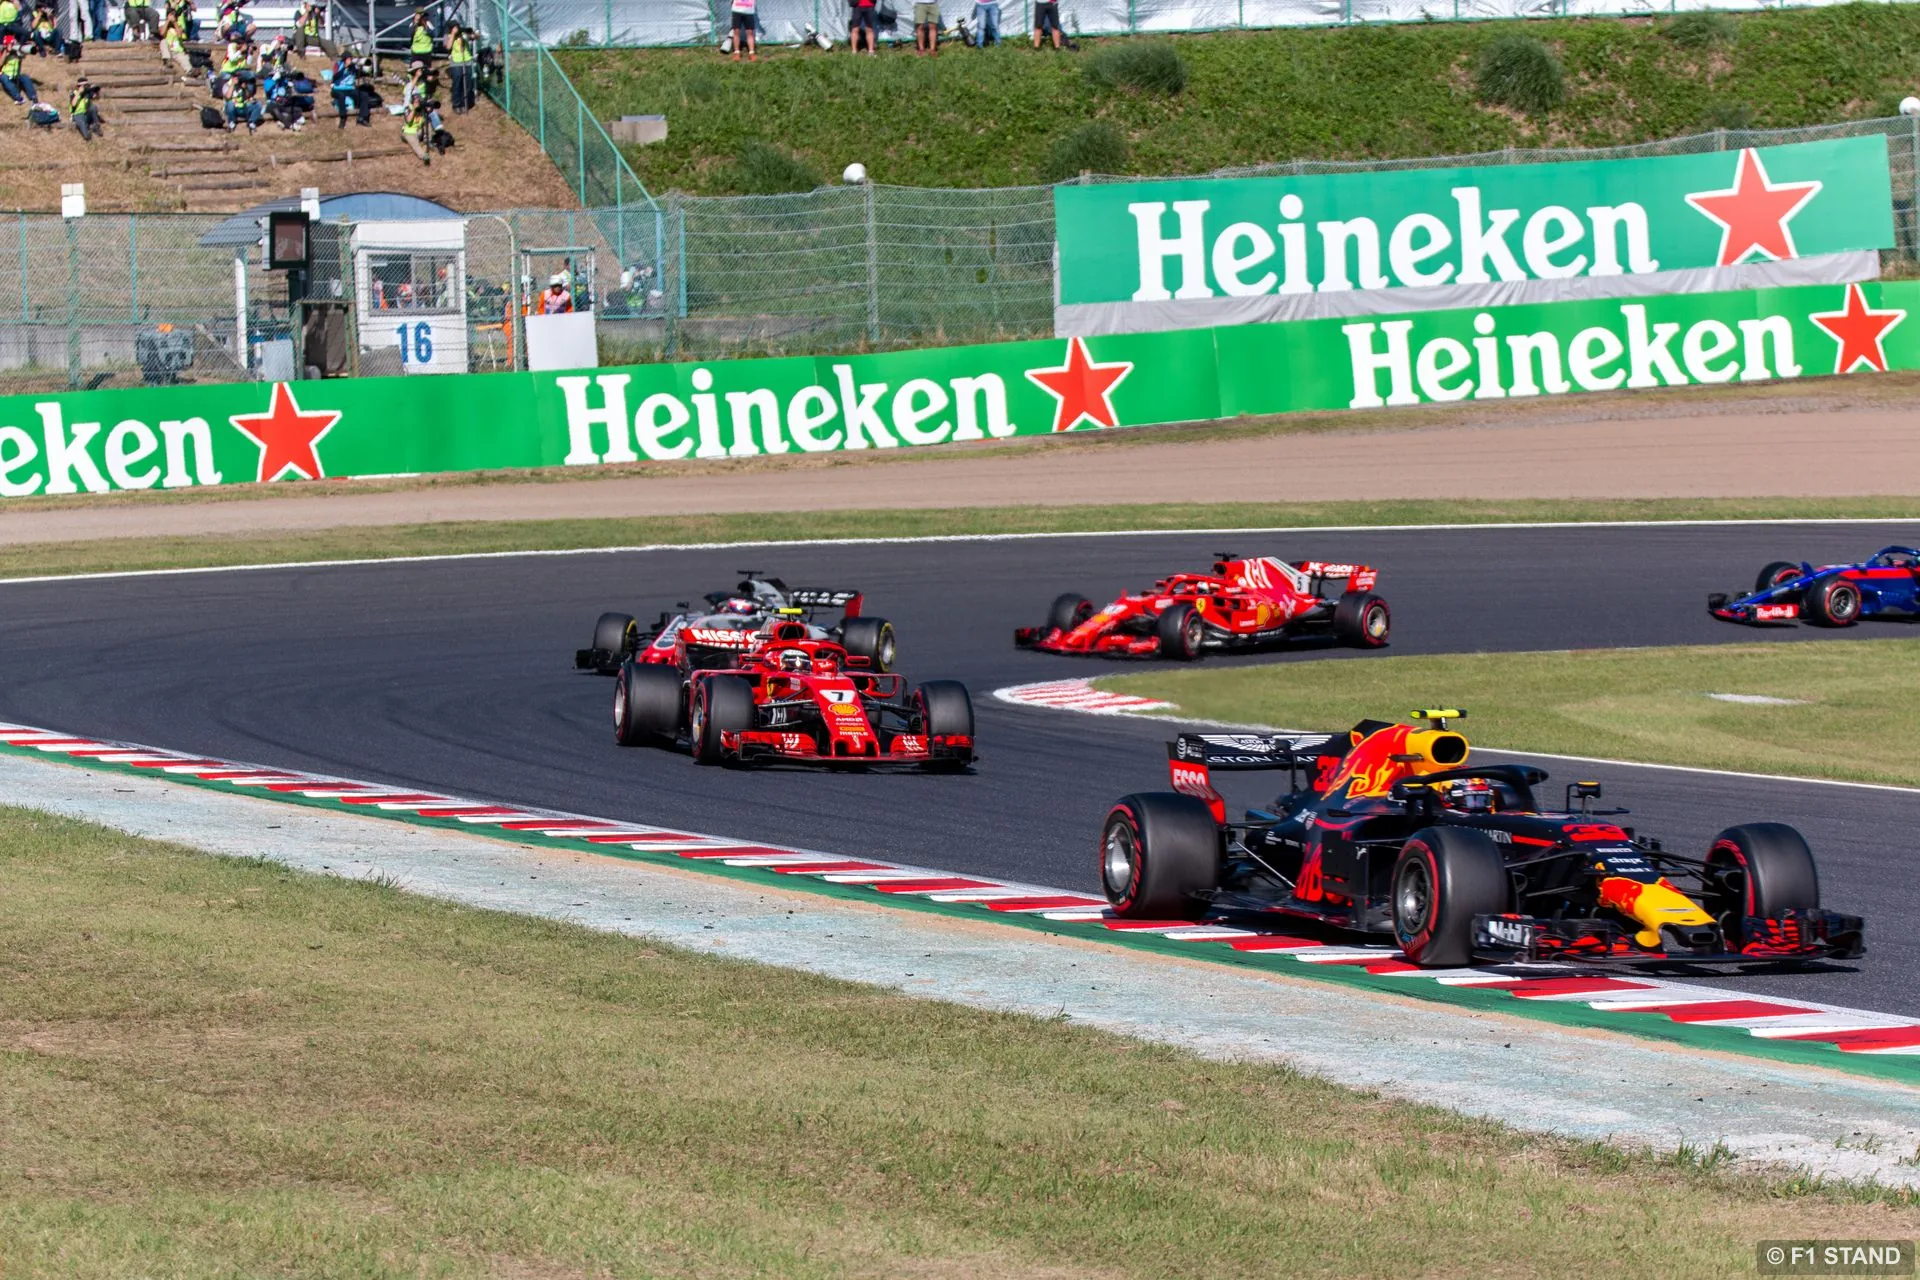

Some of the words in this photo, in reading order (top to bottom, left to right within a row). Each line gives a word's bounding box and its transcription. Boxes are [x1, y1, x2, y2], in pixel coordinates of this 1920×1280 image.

[1128, 187, 1660, 302] Heineken
[396, 321, 432, 363] 16
[1343, 304, 1802, 410] Heineken
[557, 365, 1015, 466] Heineken
[0, 403, 222, 496] eken
[1309, 562, 1353, 574] MSSION
[831, 691, 844, 701] 7
[1561, 823, 1629, 842] 33
